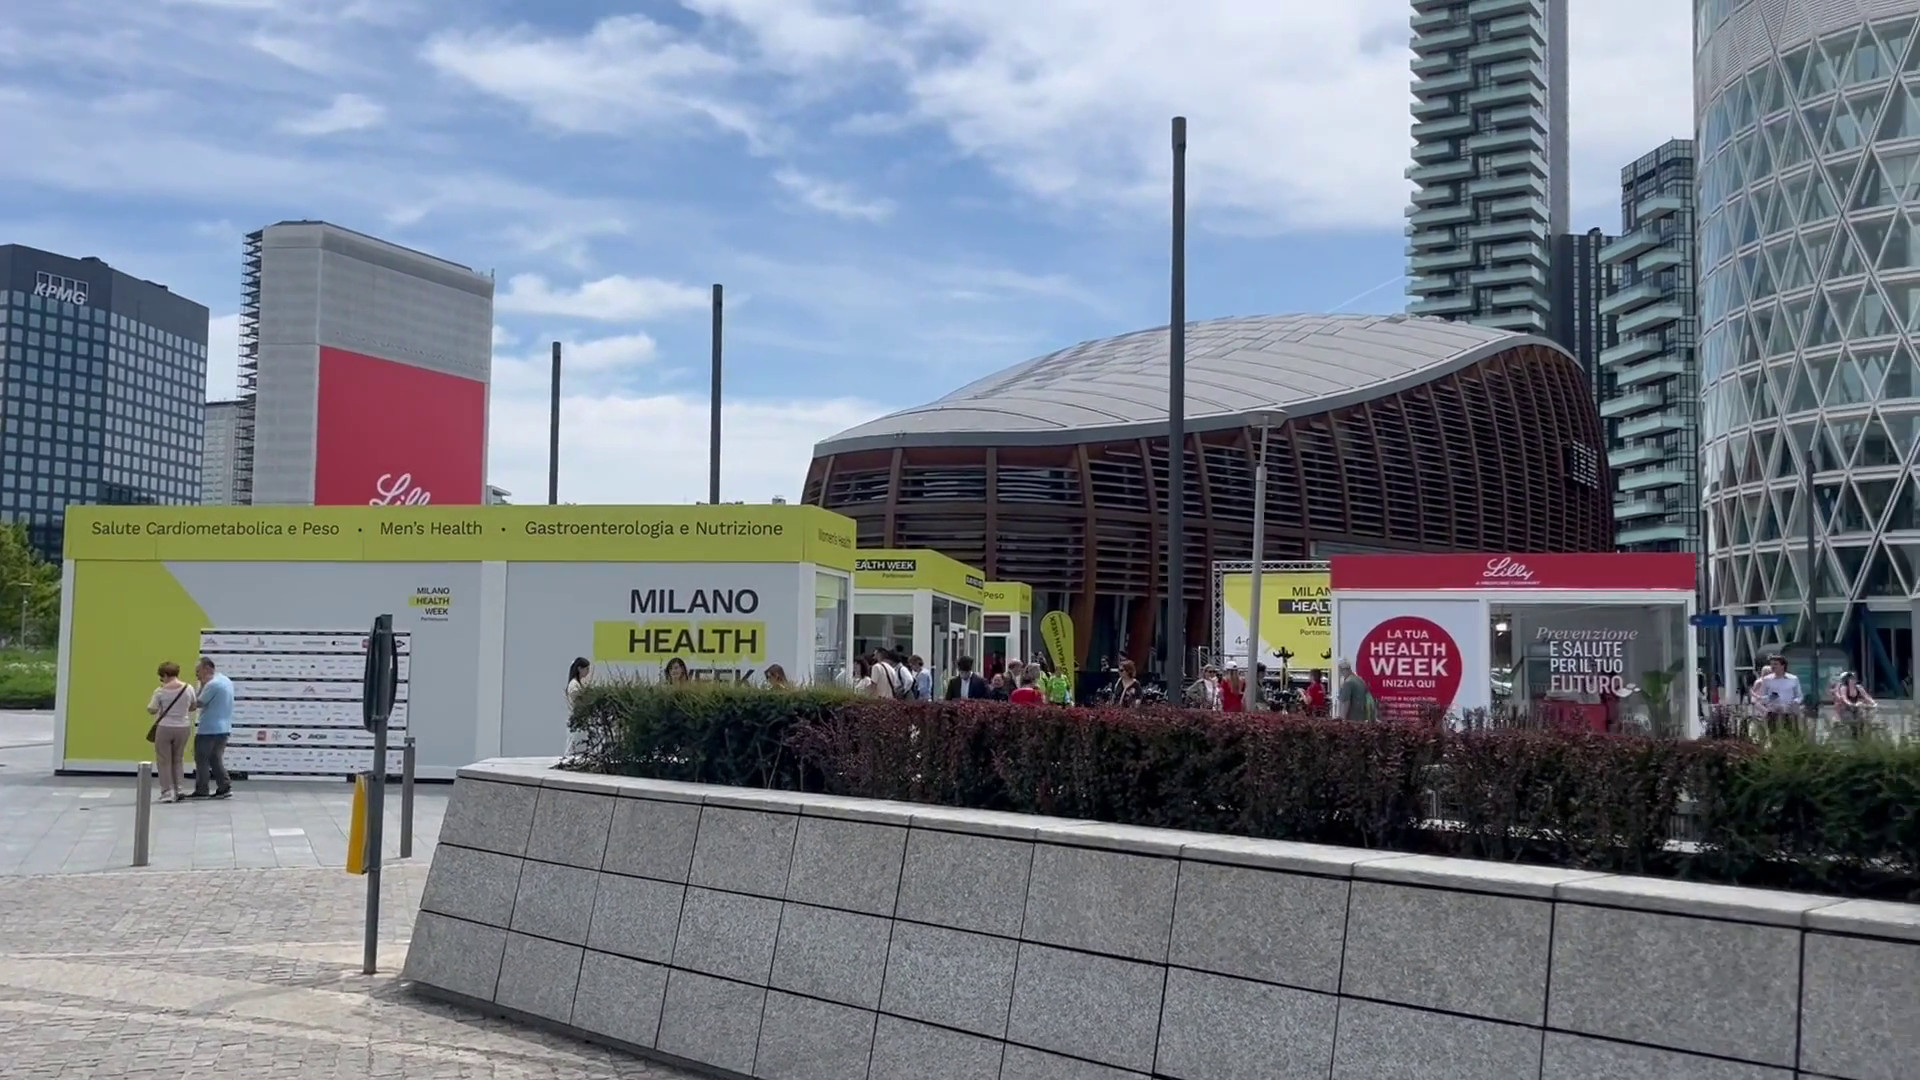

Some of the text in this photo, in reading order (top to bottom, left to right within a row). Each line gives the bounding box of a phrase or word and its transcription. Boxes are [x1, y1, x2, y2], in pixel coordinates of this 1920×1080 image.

[34, 281, 87, 305] KPMG
[368, 473, 431, 505] Lill
[91, 520, 783, 538] Salute Cardiometabolica e Peso Men's Health Gastroenterologia e Nutrizione
[856, 561, 915, 570] EALTH WEEK
[1482, 557, 1534, 580] Lilly
[417, 586, 450, 595] MILANO
[984, 592, 1005, 600] Peso
[1292, 586, 1331, 597] MILAN
[416, 597, 450, 605] HEALTH
[630, 588, 759, 614] MILANO
[1292, 601, 1331, 612] HEALT
[424, 607, 449, 616] WEEK
[1306, 616, 1331, 627] WEE
[1387, 629, 1429, 639] LA TUA
[1536, 626, 1639, 640] Prevenzione
[628, 629, 757, 654] HEALTH
[1370, 642, 1446, 656] HEALTH
[1550, 641, 1623, 657] E SALUTE
[1369, 657, 1449, 677] WEEK
[1550, 658, 1623, 673] PER IL TUO
[1382, 679, 1436, 688] INIZIA QUI
[1551, 675, 1624, 695] FUTURO
